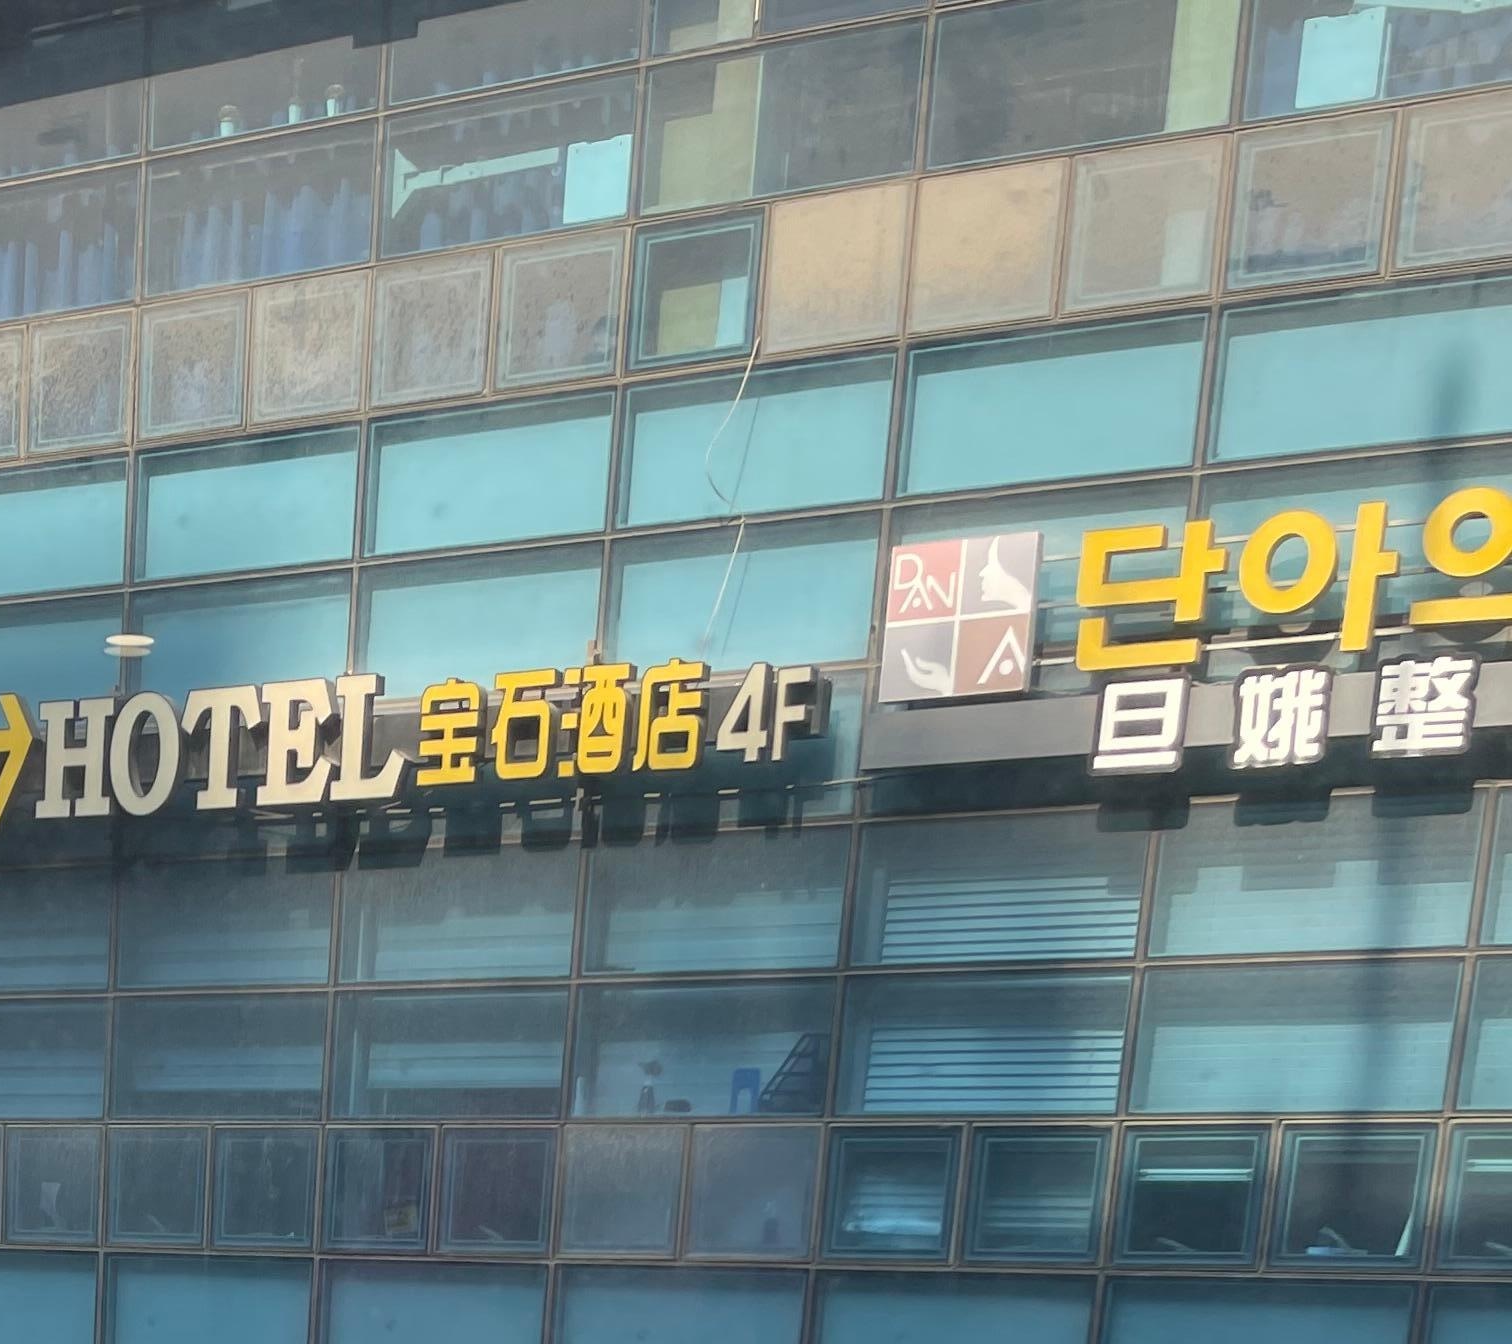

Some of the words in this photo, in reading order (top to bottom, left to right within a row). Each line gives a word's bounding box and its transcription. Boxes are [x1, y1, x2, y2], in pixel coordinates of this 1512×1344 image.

[36, 673, 407, 820] HOTEL
[417, 657, 712, 788] 宝石酒店
[716, 662, 819, 764] 4F
[1092, 655, 1477, 772] 旦娥整
